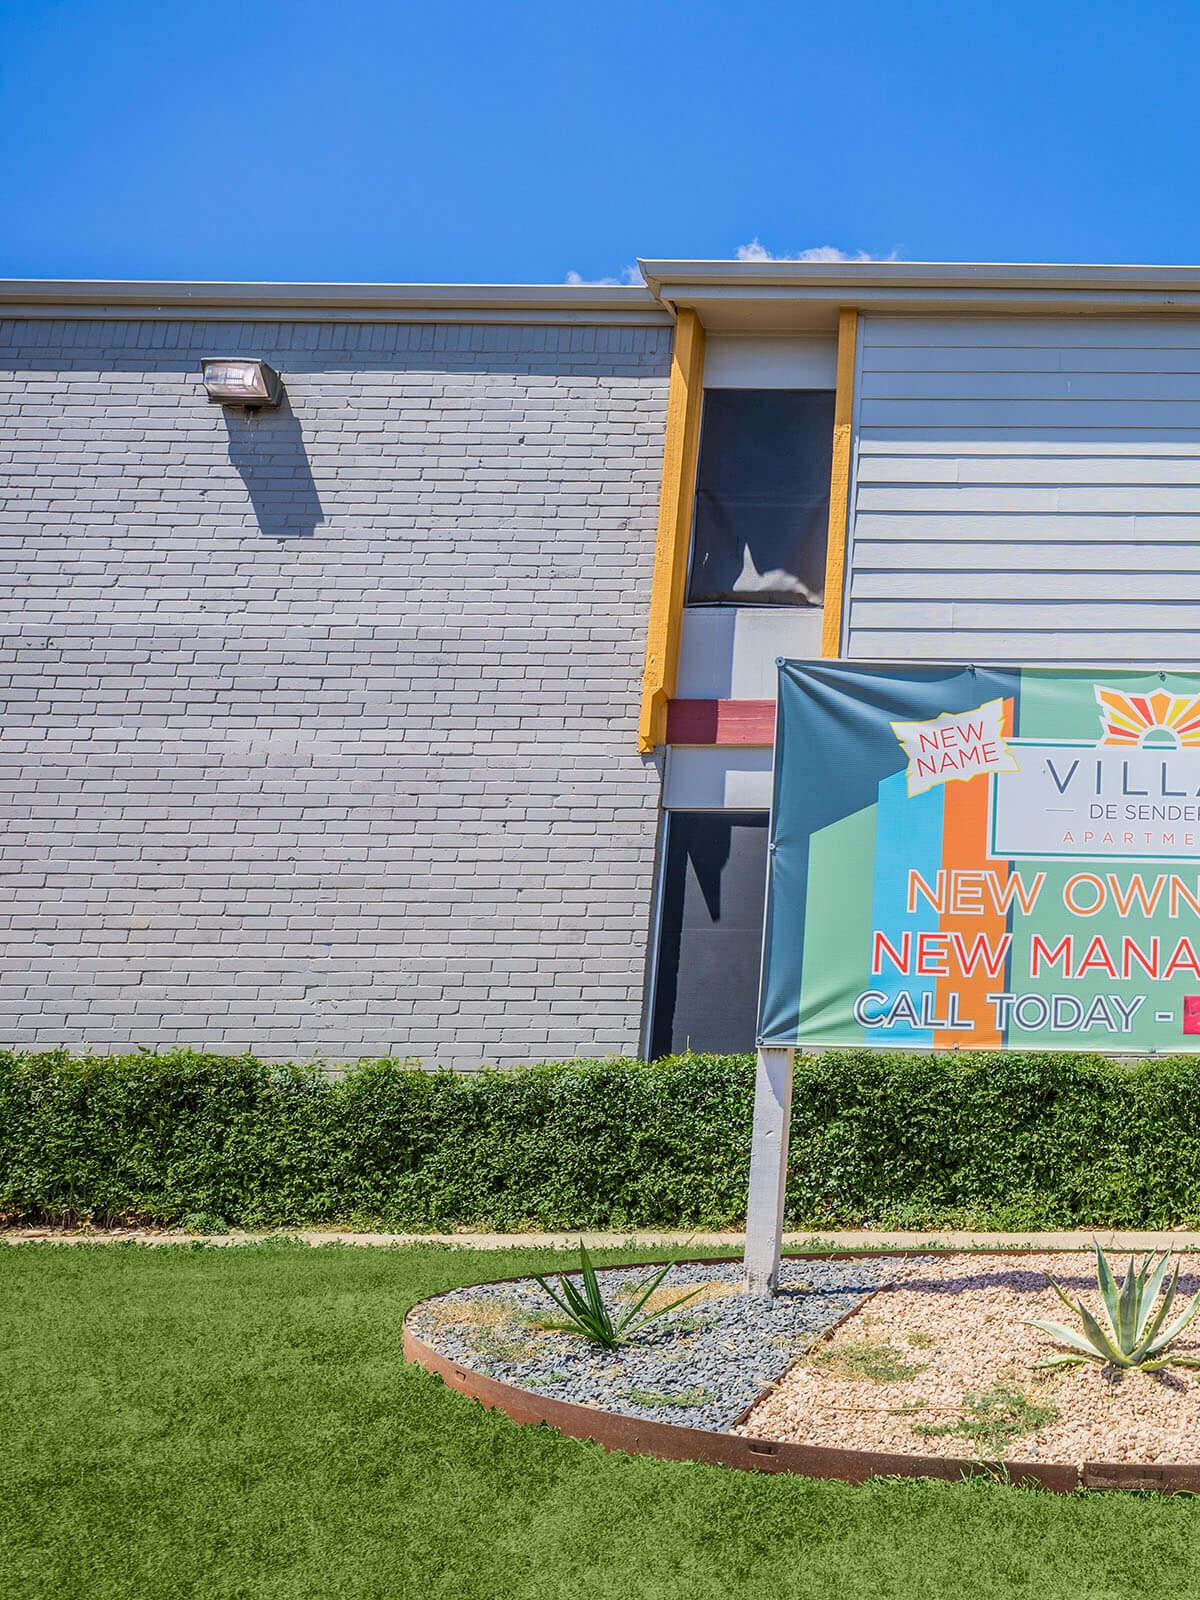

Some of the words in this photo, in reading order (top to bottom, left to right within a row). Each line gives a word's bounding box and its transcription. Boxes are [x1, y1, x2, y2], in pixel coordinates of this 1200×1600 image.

[918, 721, 984, 753] NEW
[916, 742, 999, 777] NAME
[1089, 803, 1118, 820] DE
[907, 869, 1046, 916] NEW
[871, 931, 1012, 977] NEW
[854, 990, 975, 1030] CALL
[986, 993, 1145, 1032] TODAY
